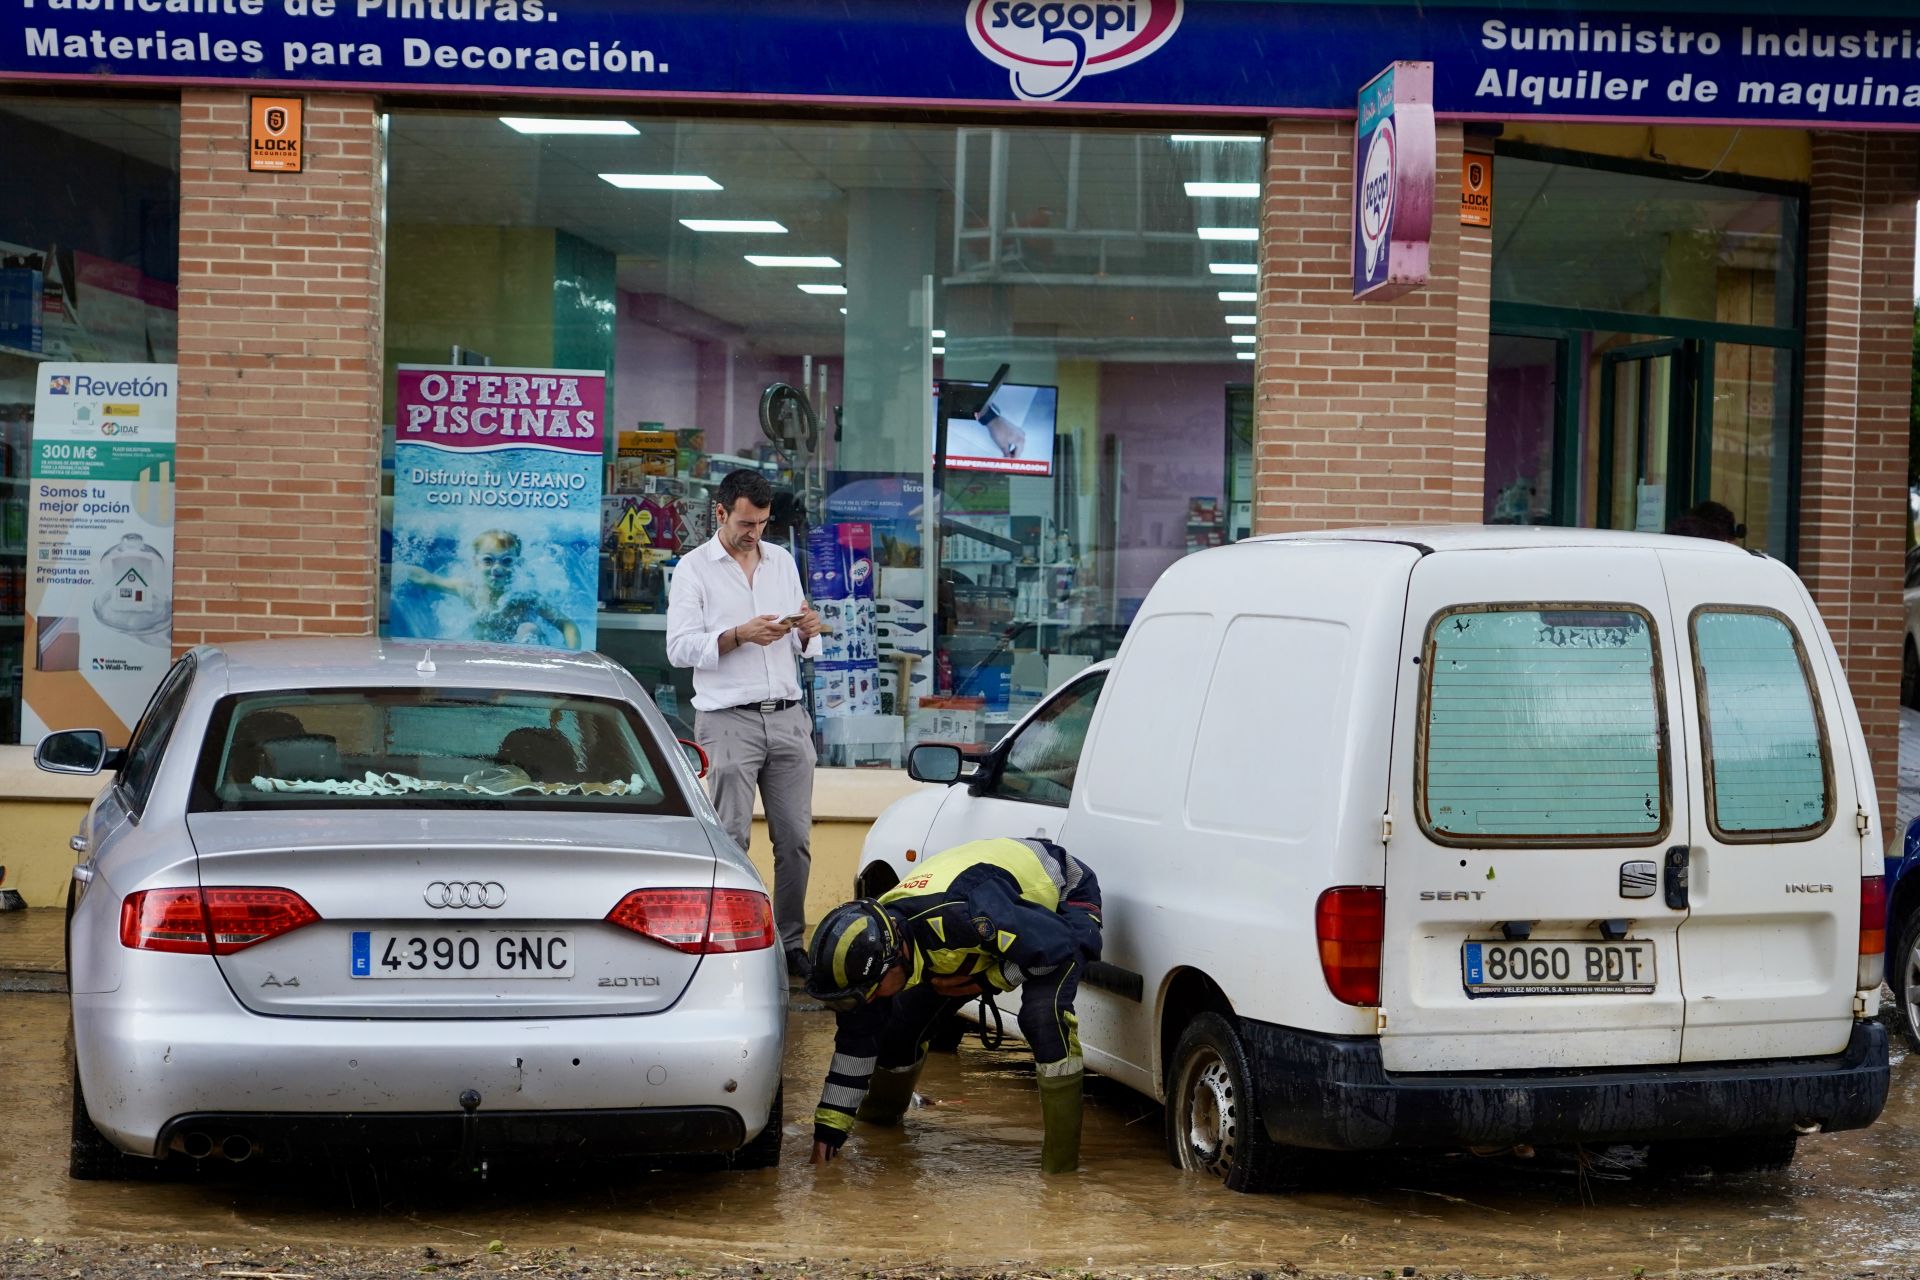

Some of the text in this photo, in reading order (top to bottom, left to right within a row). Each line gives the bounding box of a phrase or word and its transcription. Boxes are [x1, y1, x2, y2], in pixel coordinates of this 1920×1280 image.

[284, 0, 336, 16] de
[356, 0, 558, 22] Pinturas.
[992, 2, 1136, 62] segopi
[1481, 19, 1721, 55] Suministro
[25, 27, 669, 72] Materiales para Decoración.
[1475, 68, 1649, 106] Alquiler
[1667, 73, 1719, 102] de
[254, 138, 297, 151] LOCK
[1461, 193, 1489, 206] LOCK
[75, 376, 168, 397] Revetón
[420, 374, 582, 406] OFERTA
[120, 425, 140, 434] IDAE
[406, 404, 594, 438] PISCINAS
[42, 445, 70, 459] 300
[412, 468, 585, 490] Disfruta tu VERANO
[40, 485, 105, 498] Somos tu
[902, 484, 924, 493] tkro
[40, 500, 130, 515] mejor opción
[426, 490, 569, 508] con NOSOTROS
[37, 566, 77, 576] Pregunta
[36, 576, 95, 585] el mostrador.
[1419, 890, 1486, 901] SEAT
[1785, 882, 1834, 893] INCA
[357, 936, 568, 971] E 4390 GNC
[1471, 946, 1643, 982] E 8060 BDT
[260, 972, 301, 988] A4
